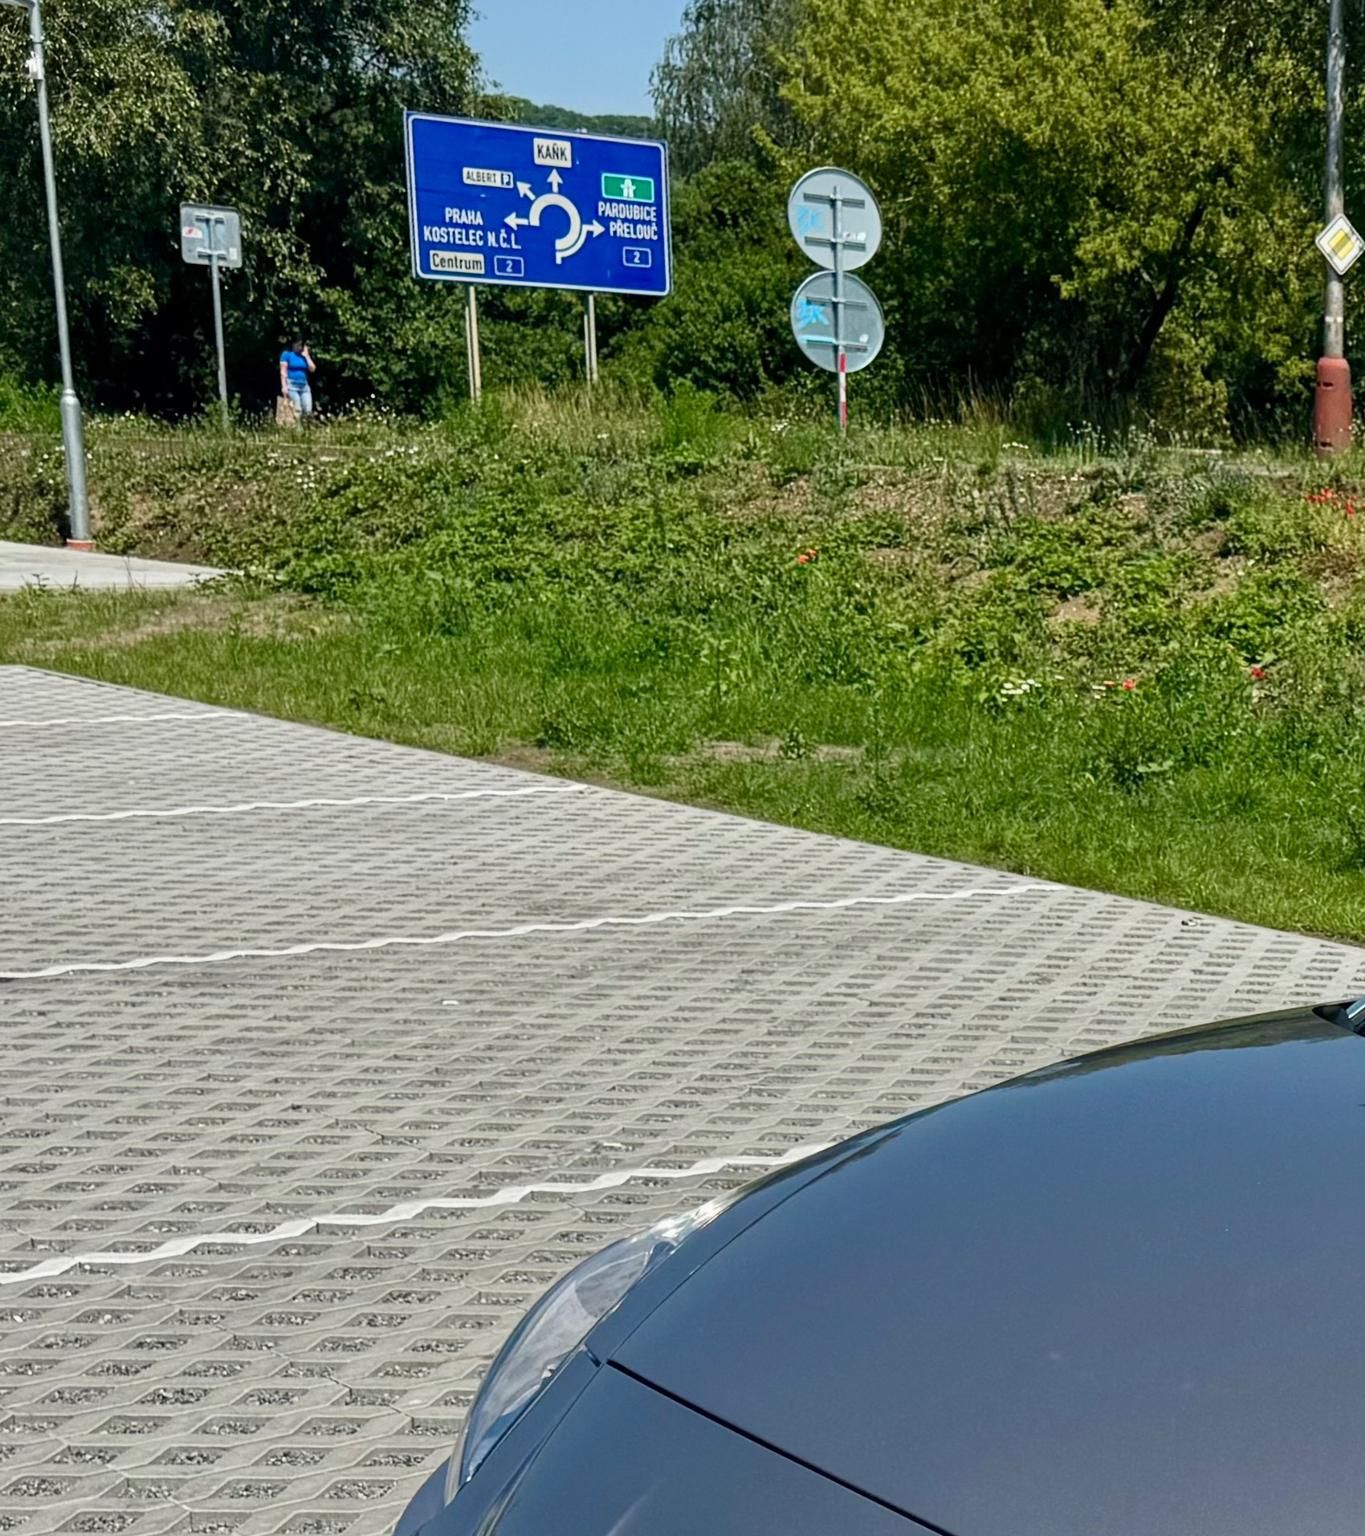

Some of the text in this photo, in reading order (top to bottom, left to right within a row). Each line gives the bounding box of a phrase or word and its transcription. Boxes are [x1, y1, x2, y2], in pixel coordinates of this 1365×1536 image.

[537, 143, 568, 161] KAŇK
[466, 170, 497, 184] ALBERT
[445, 207, 483, 226] PRAHA
[598, 201, 657, 221] PARDUBICE
[423, 225, 484, 246] KOSTELEC
[609, 219, 658, 240] PŘELOUČ
[432, 253, 482, 271] Centrum
[633, 251, 640, 263] 2
[505, 260, 513, 273] 2
